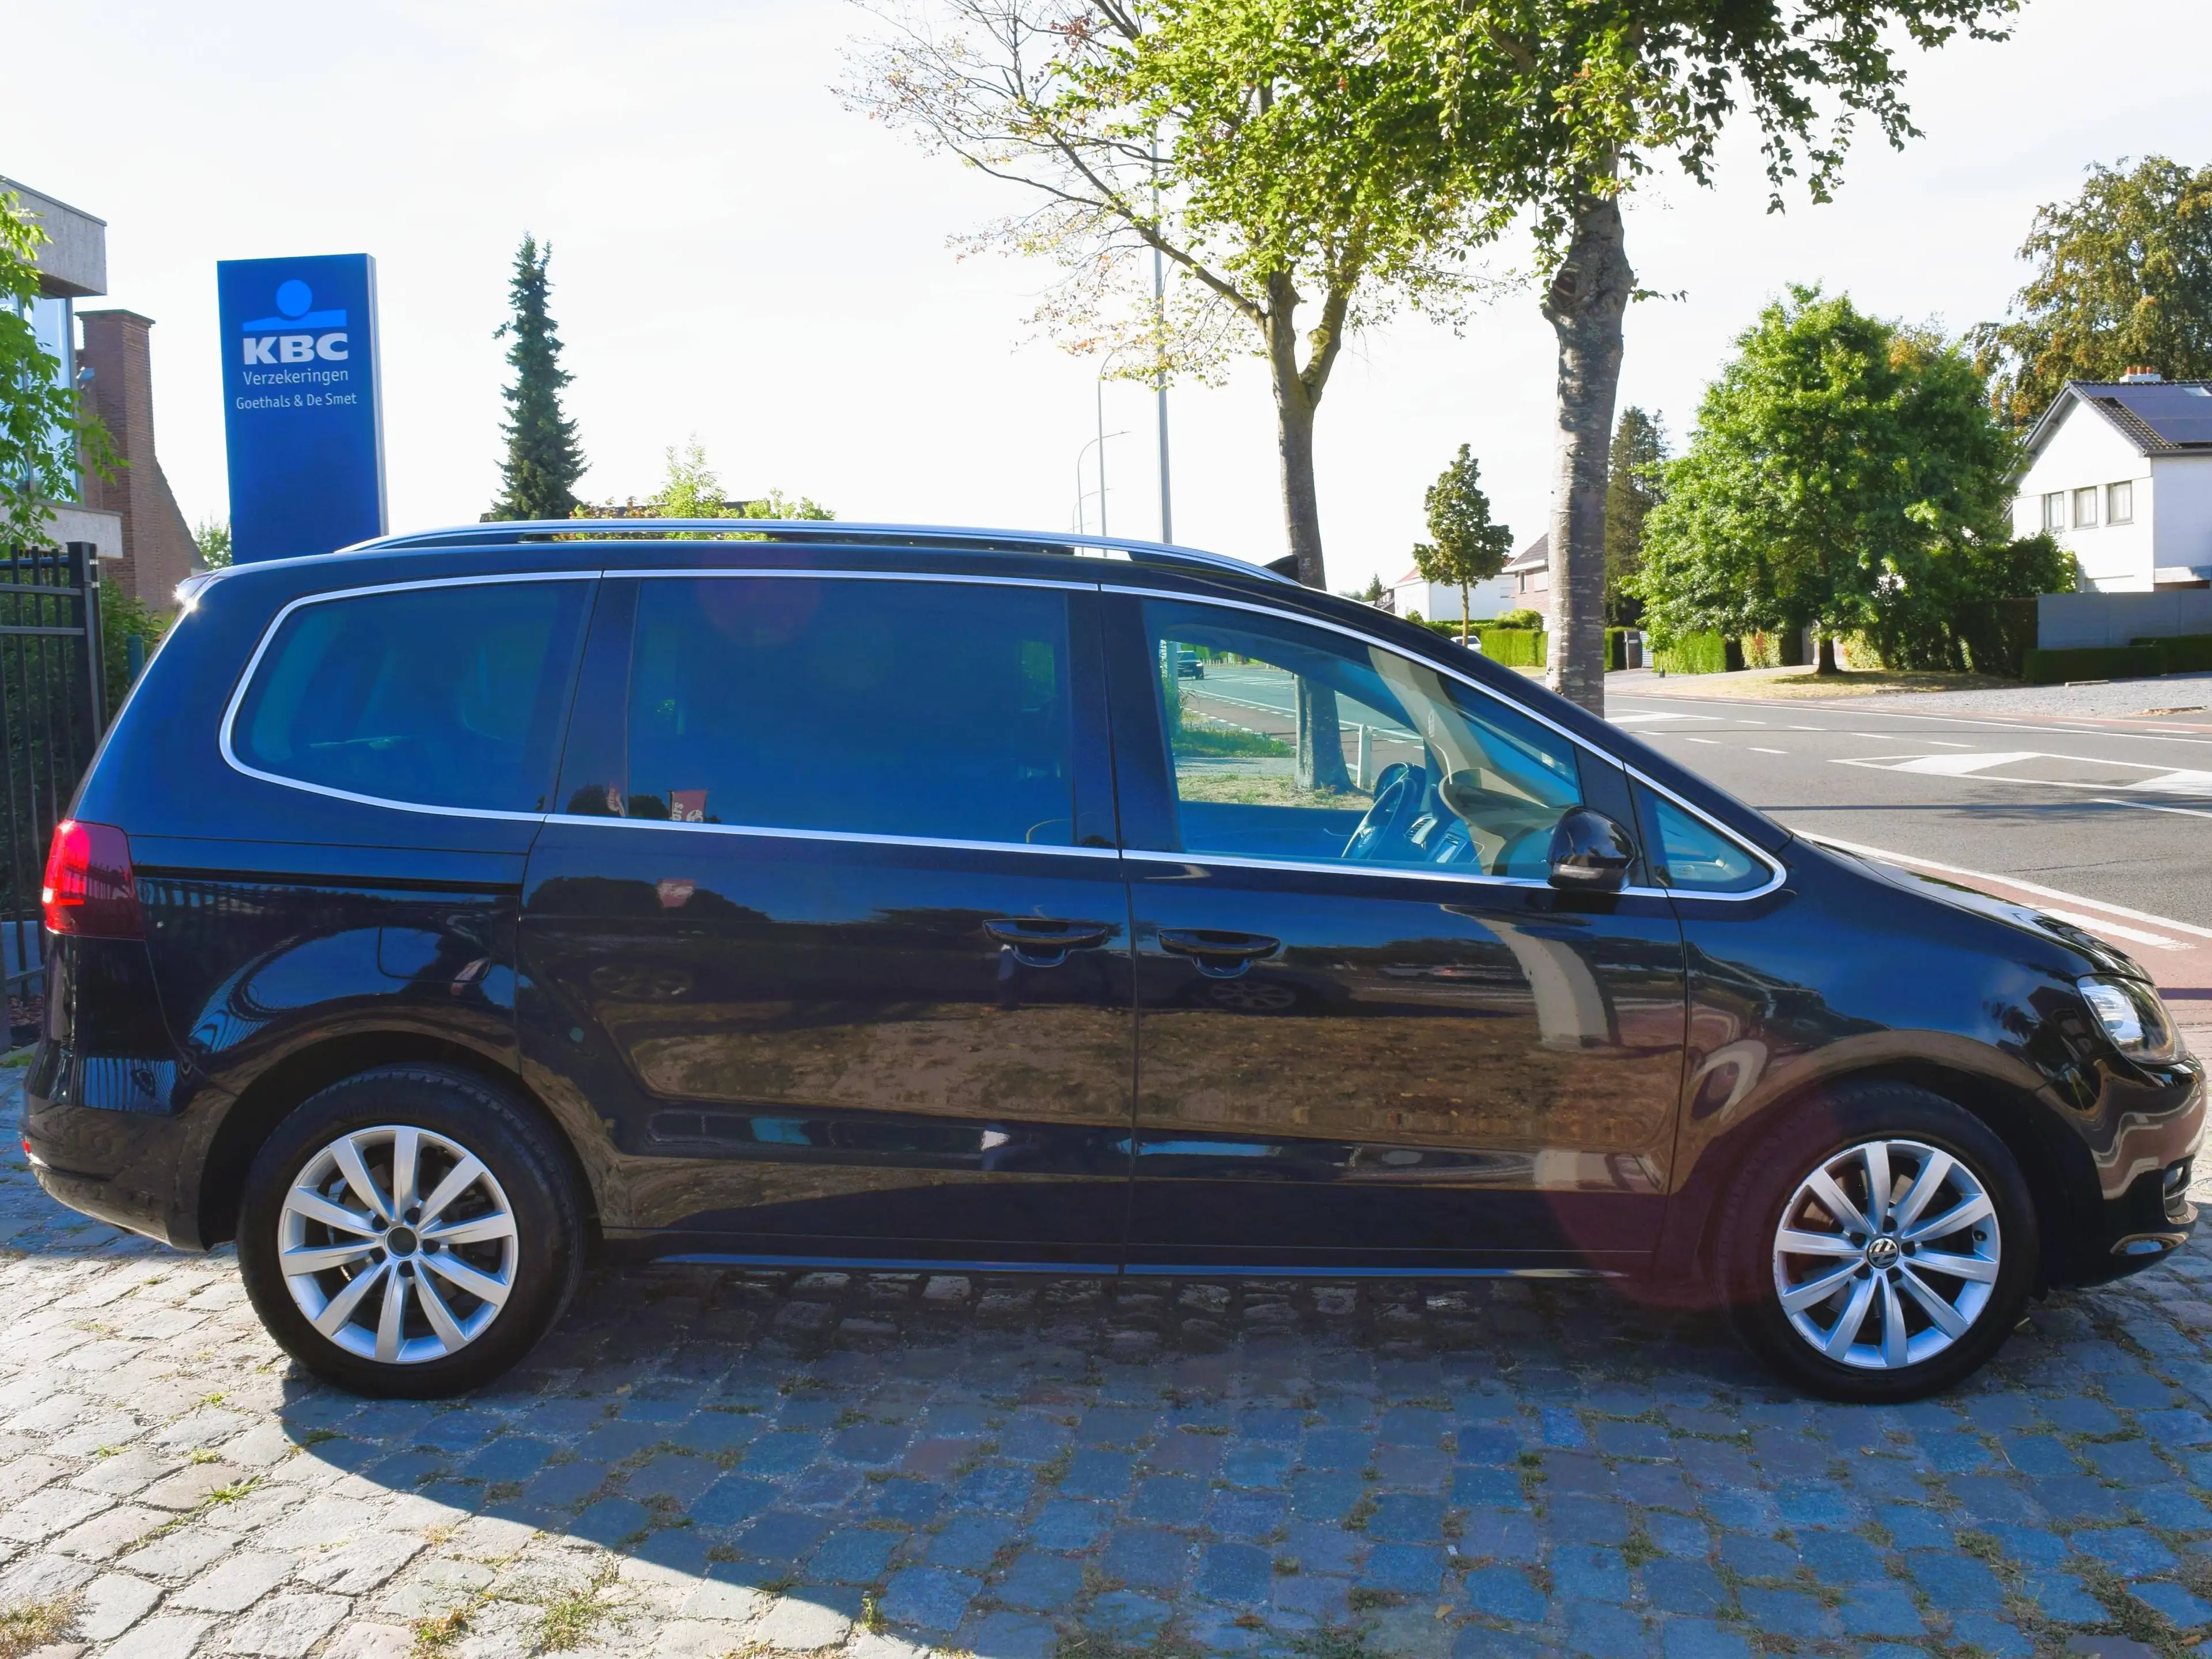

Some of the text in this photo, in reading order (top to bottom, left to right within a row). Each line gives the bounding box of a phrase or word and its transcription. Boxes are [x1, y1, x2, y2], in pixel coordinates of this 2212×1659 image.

[243, 332, 349, 365] KBC
[243, 368, 349, 385] Verzekeringen
[236, 393, 358, 409] Goethals & De Smet
